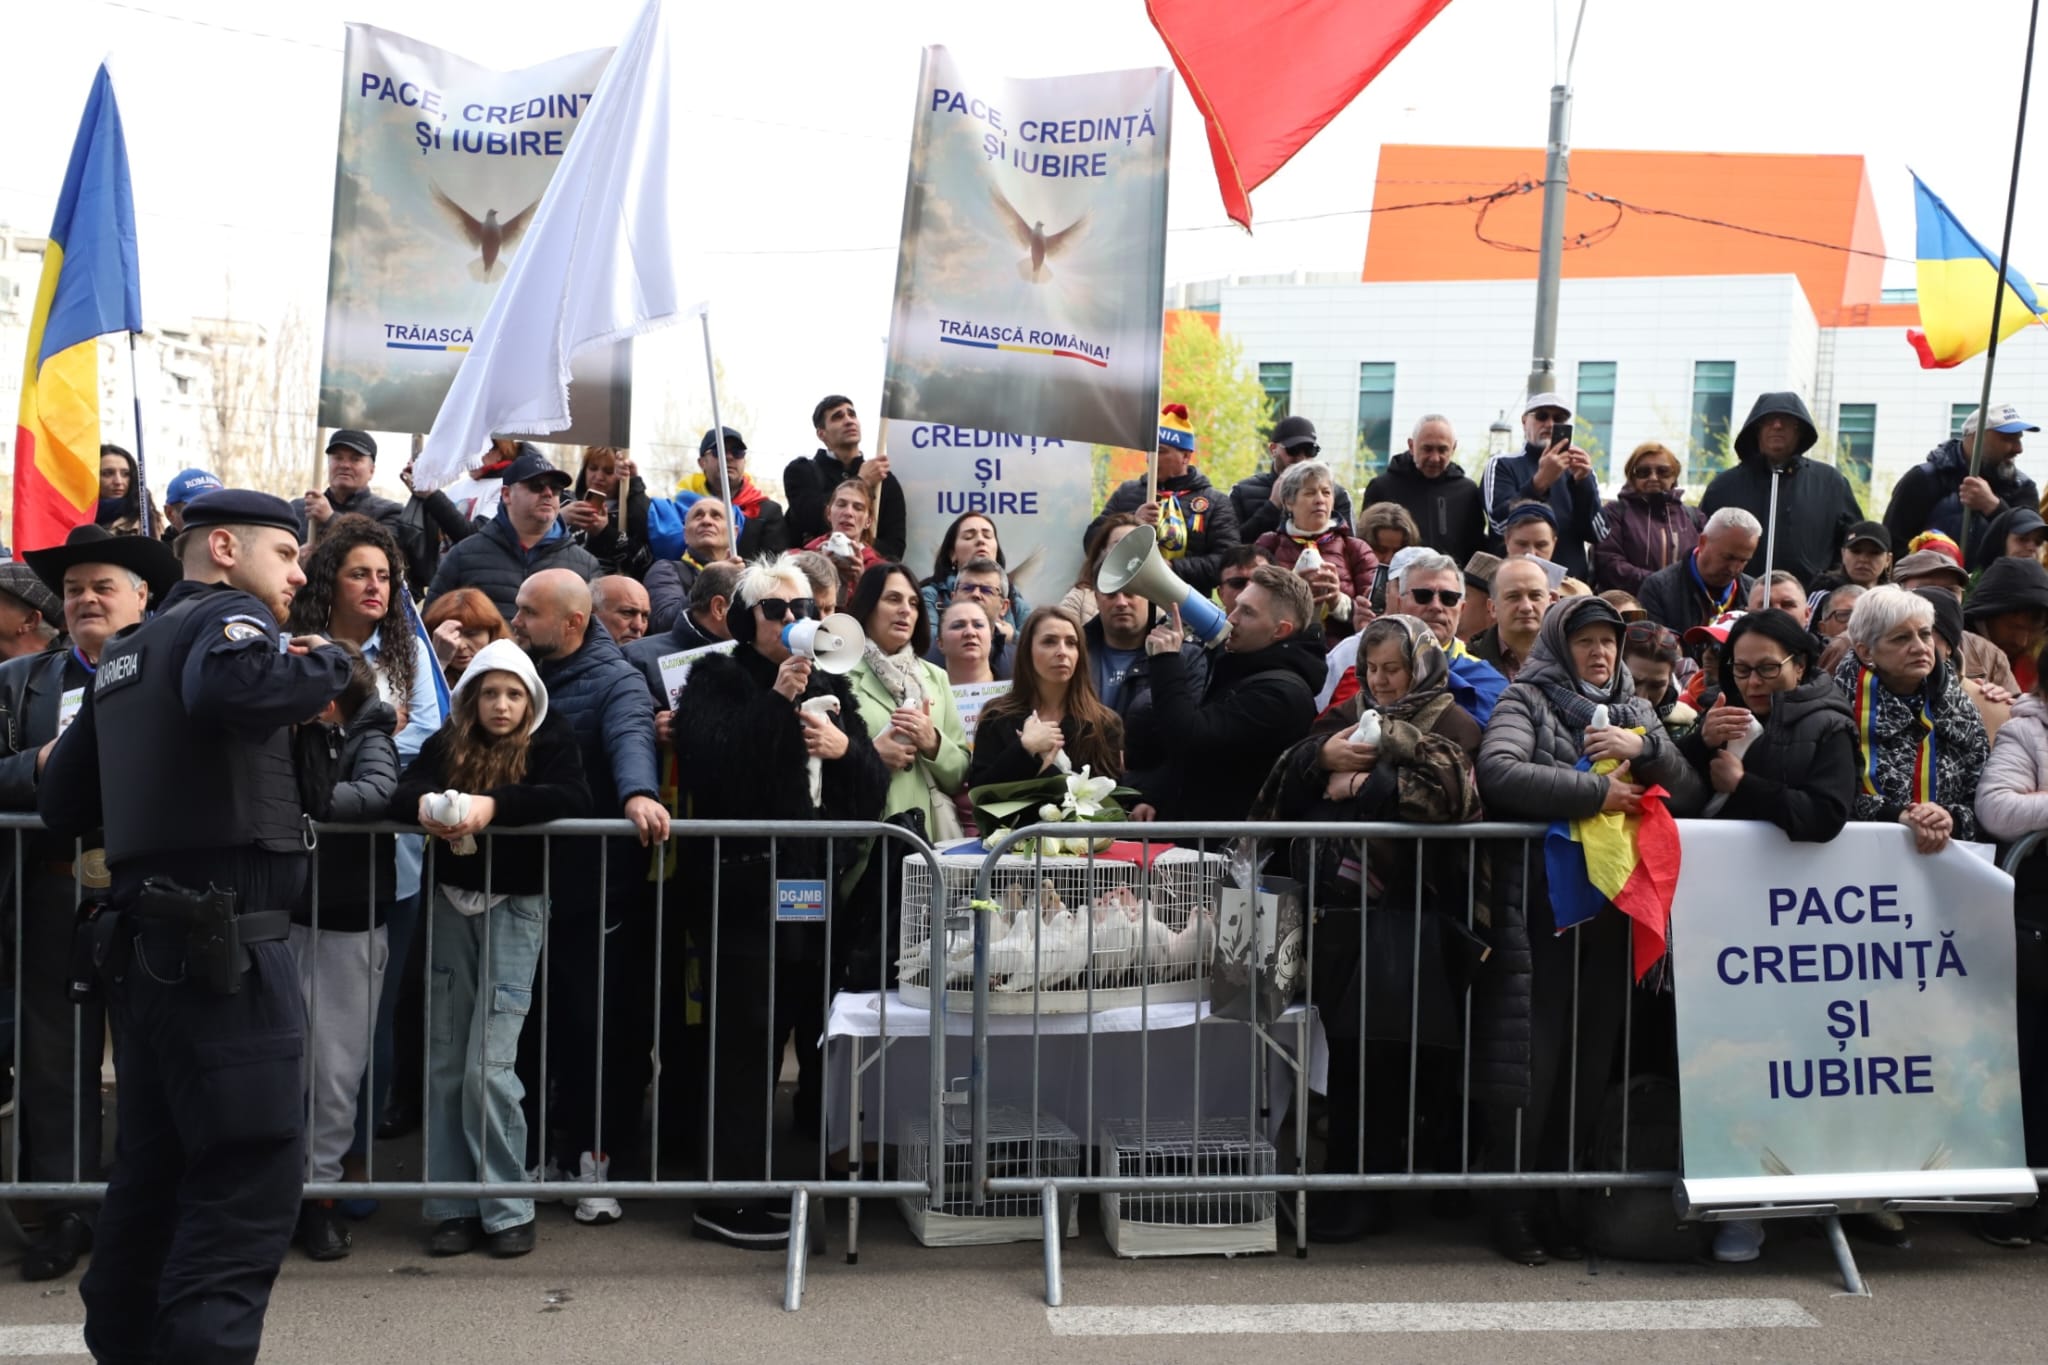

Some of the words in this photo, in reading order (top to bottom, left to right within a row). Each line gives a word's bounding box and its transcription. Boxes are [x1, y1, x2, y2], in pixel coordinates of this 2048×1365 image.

[361, 72, 447, 121] PACE,
[932, 88, 1007, 137] PACE,
[1019, 107, 1156, 146] CREDINȚĂ
[416, 121, 441, 155] ȘI
[452, 129, 564, 156] IUBIRE
[983, 133, 1005, 161] ȘI
[1014, 147, 1107, 178] IUBIRE
[384, 323, 474, 343] TRĂIASCĂ
[939, 319, 1024, 343] TRĂIASCĂ
[1029, 330, 1111, 360] ROMÂNIA!
[974, 458, 1002, 488] ȘI
[937, 491, 1039, 515] IUBIRE
[780, 889, 823, 902] DGJMB
[1768, 884, 1913, 930] PACE,
[1716, 929, 1968, 993] CREDINȚĂ
[1826, 999, 1870, 1052] ȘI
[1768, 1055, 1934, 1099] IUBIRE
